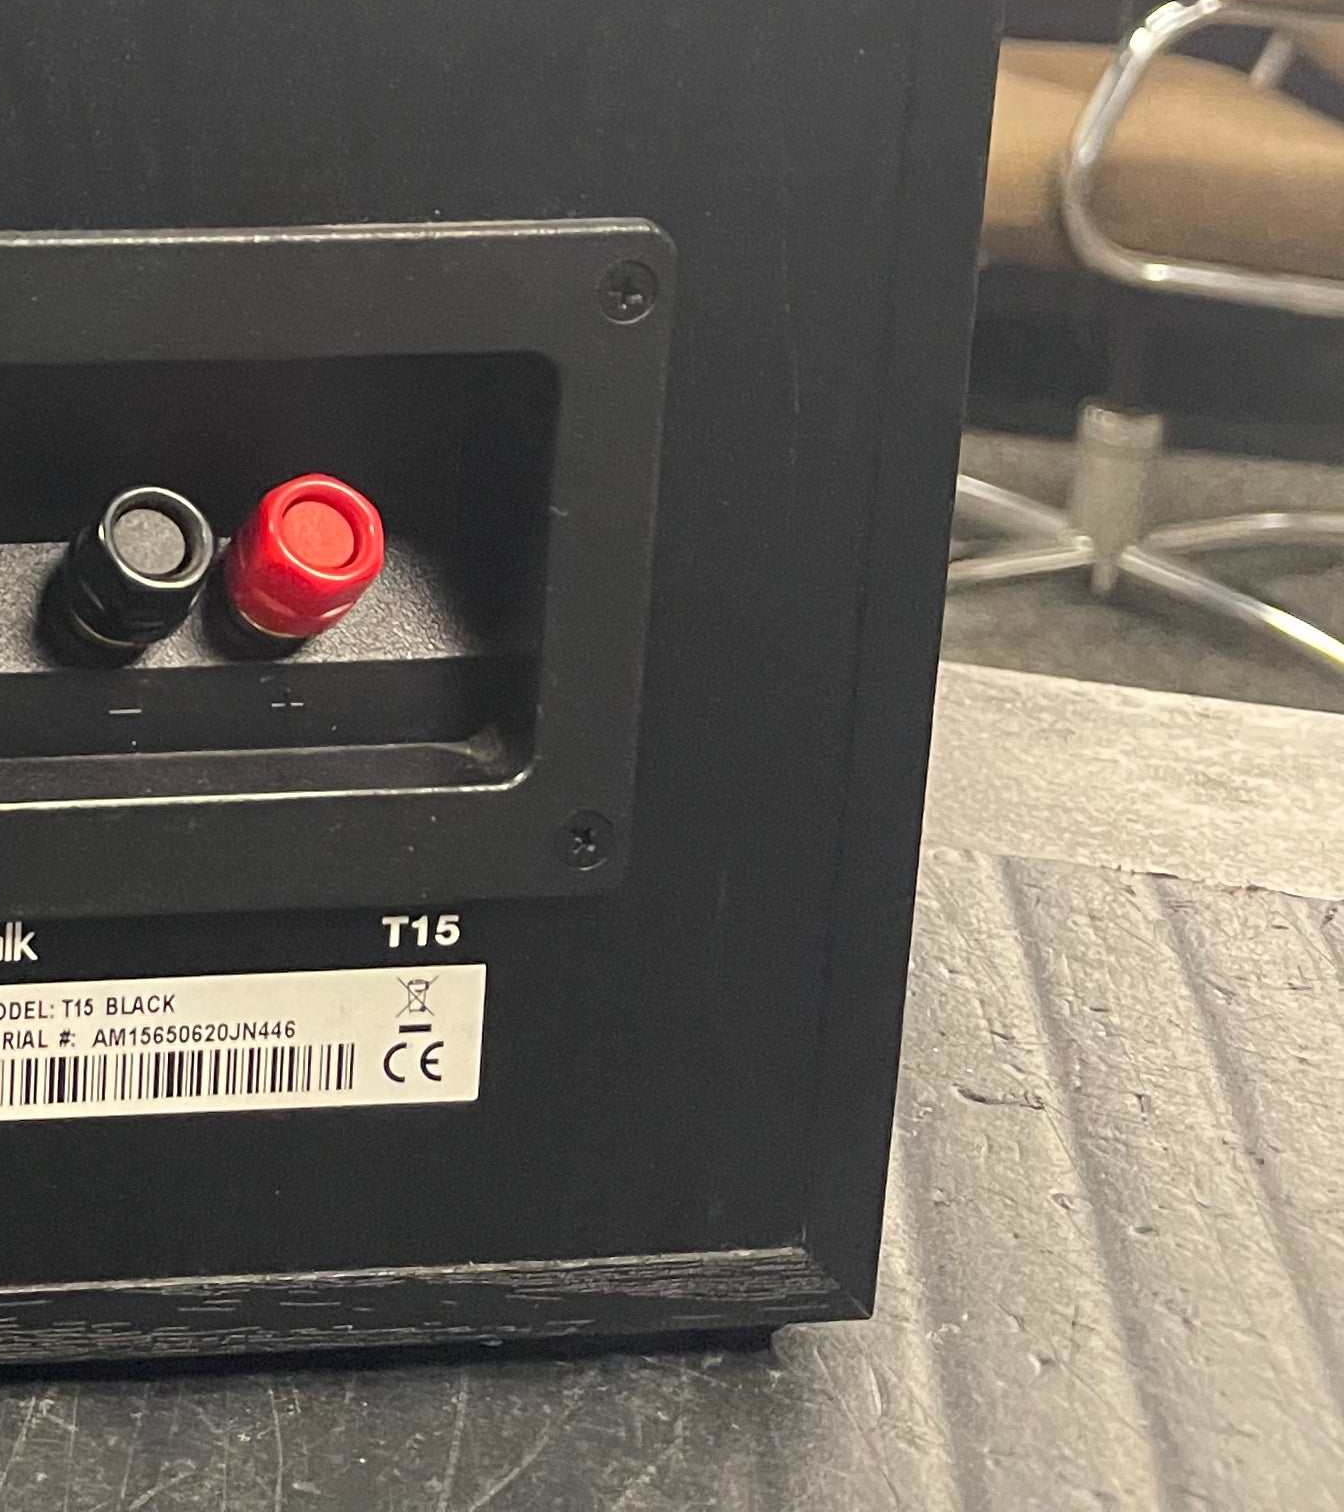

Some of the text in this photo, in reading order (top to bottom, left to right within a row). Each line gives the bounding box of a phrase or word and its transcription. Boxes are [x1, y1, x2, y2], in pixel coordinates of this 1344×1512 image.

[381, 914, 460, 948] T15
[61, 998, 94, 1018] T15
[106, 994, 175, 1016] BLACK
[91, 1020, 296, 1049] AM15650620JN446
[383, 1040, 444, 1083] CE
